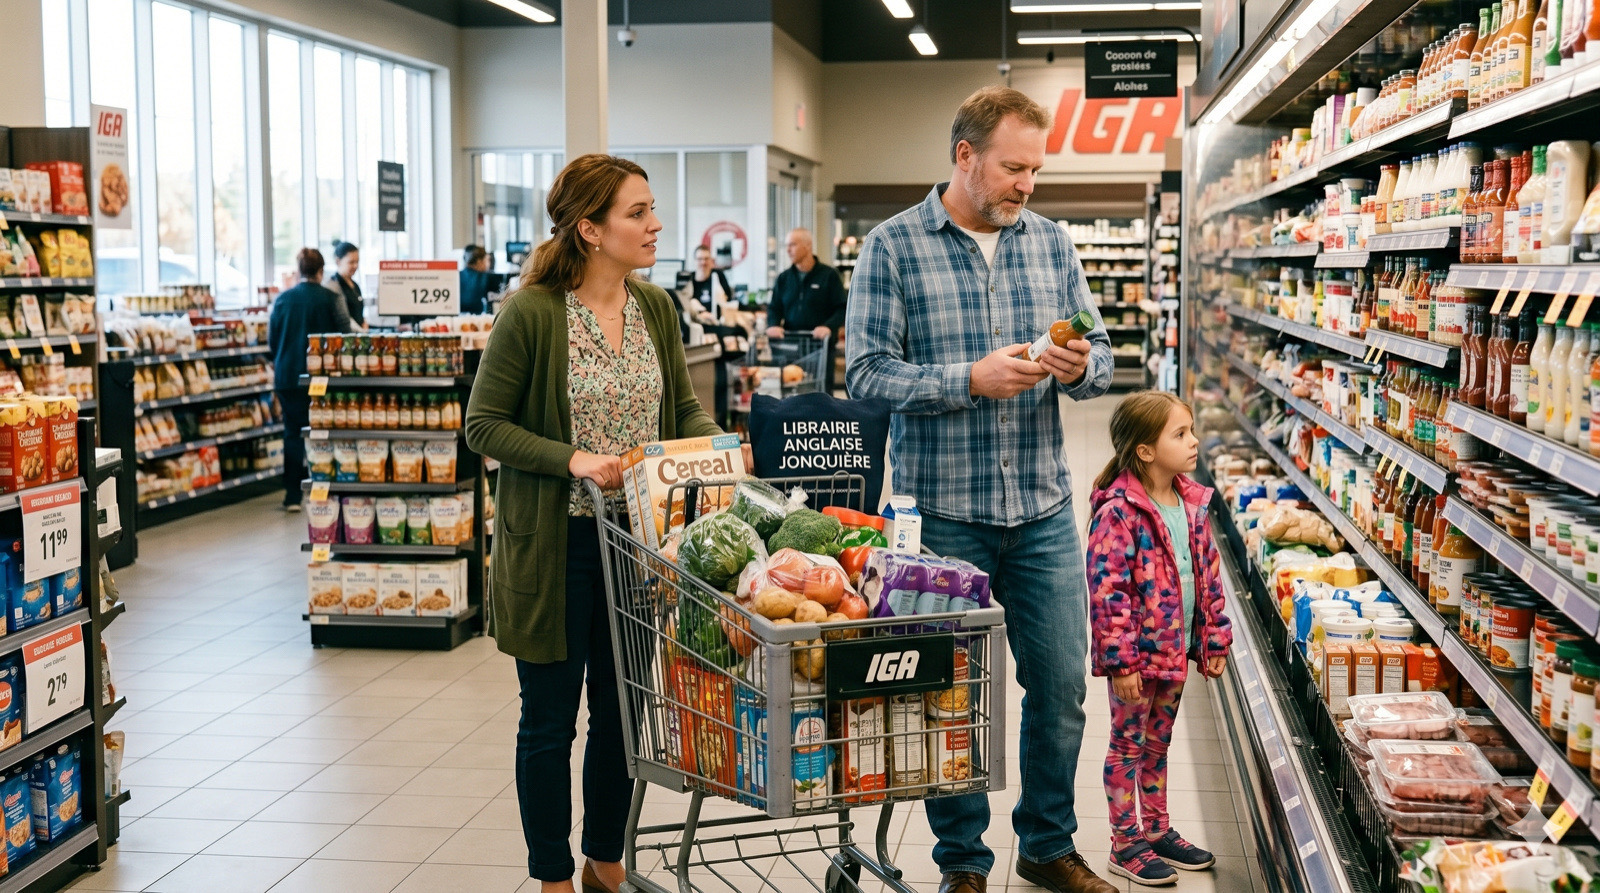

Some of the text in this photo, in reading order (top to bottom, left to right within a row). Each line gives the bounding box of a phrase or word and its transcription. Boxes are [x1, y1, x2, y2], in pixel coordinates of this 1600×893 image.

[1143, 49, 1157, 59] de
[97, 111, 123, 137] IGA
[1045, 88, 1182, 154] IGA
[411, 288, 450, 304] 12.99
[783, 421, 860, 435] LIBRAIRIE
[784, 437, 863, 452] ANGLAISE
[657, 451, 734, 485] Cereal
[779, 451, 871, 470] JONQUIÈRE
[865, 650, 920, 683] IGA
